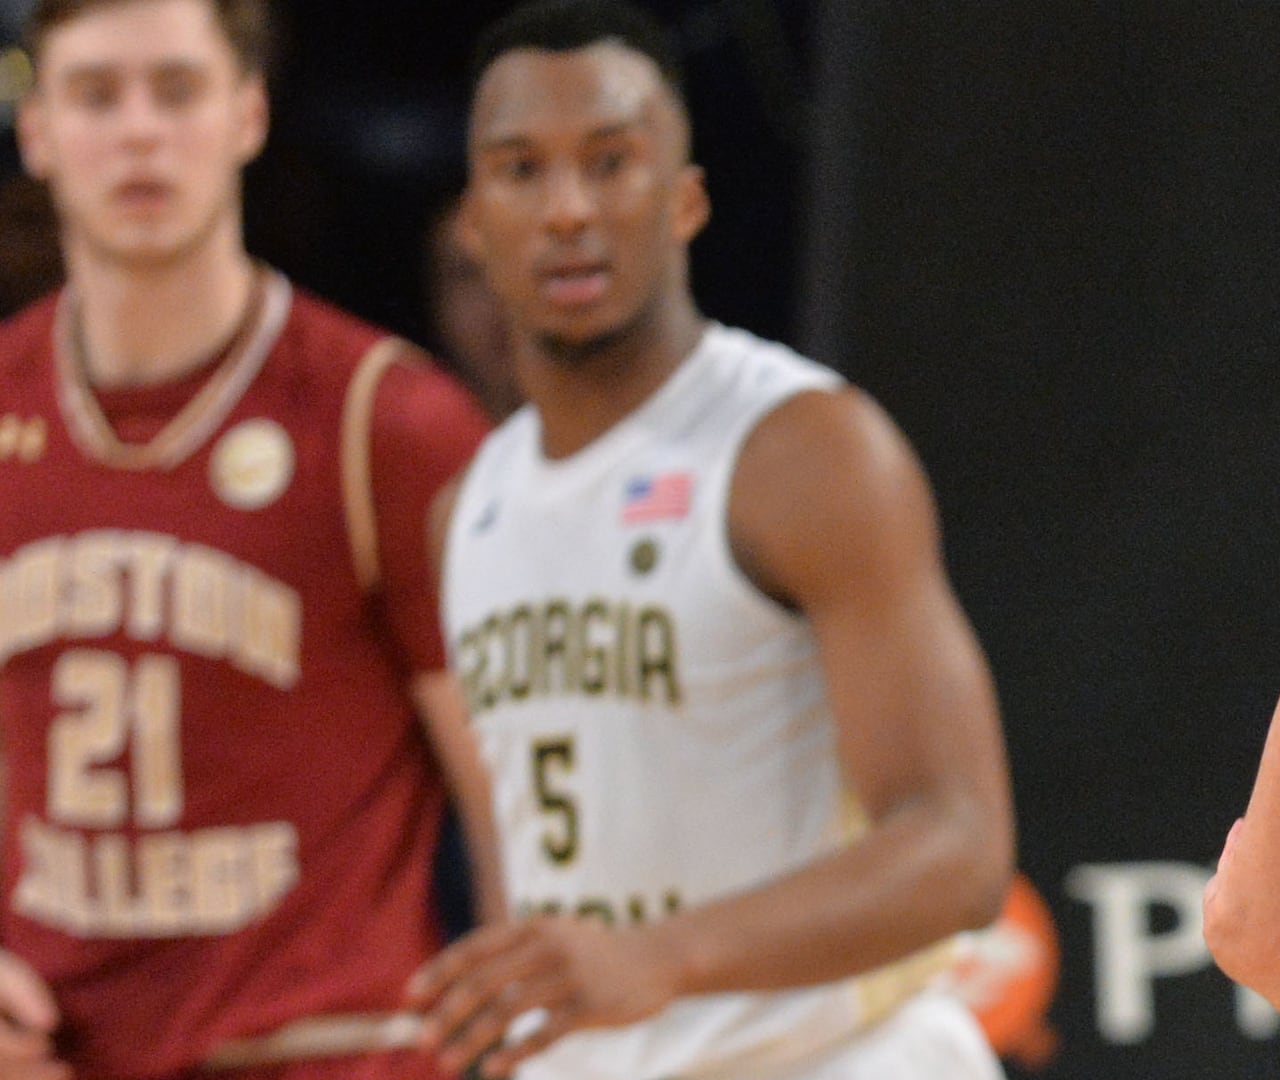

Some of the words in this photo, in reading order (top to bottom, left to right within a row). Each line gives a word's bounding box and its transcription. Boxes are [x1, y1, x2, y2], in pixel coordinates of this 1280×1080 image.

[0, 527, 302, 692] OSTON
[47, 644, 184, 830] 21
[530, 732, 581, 870] 5
